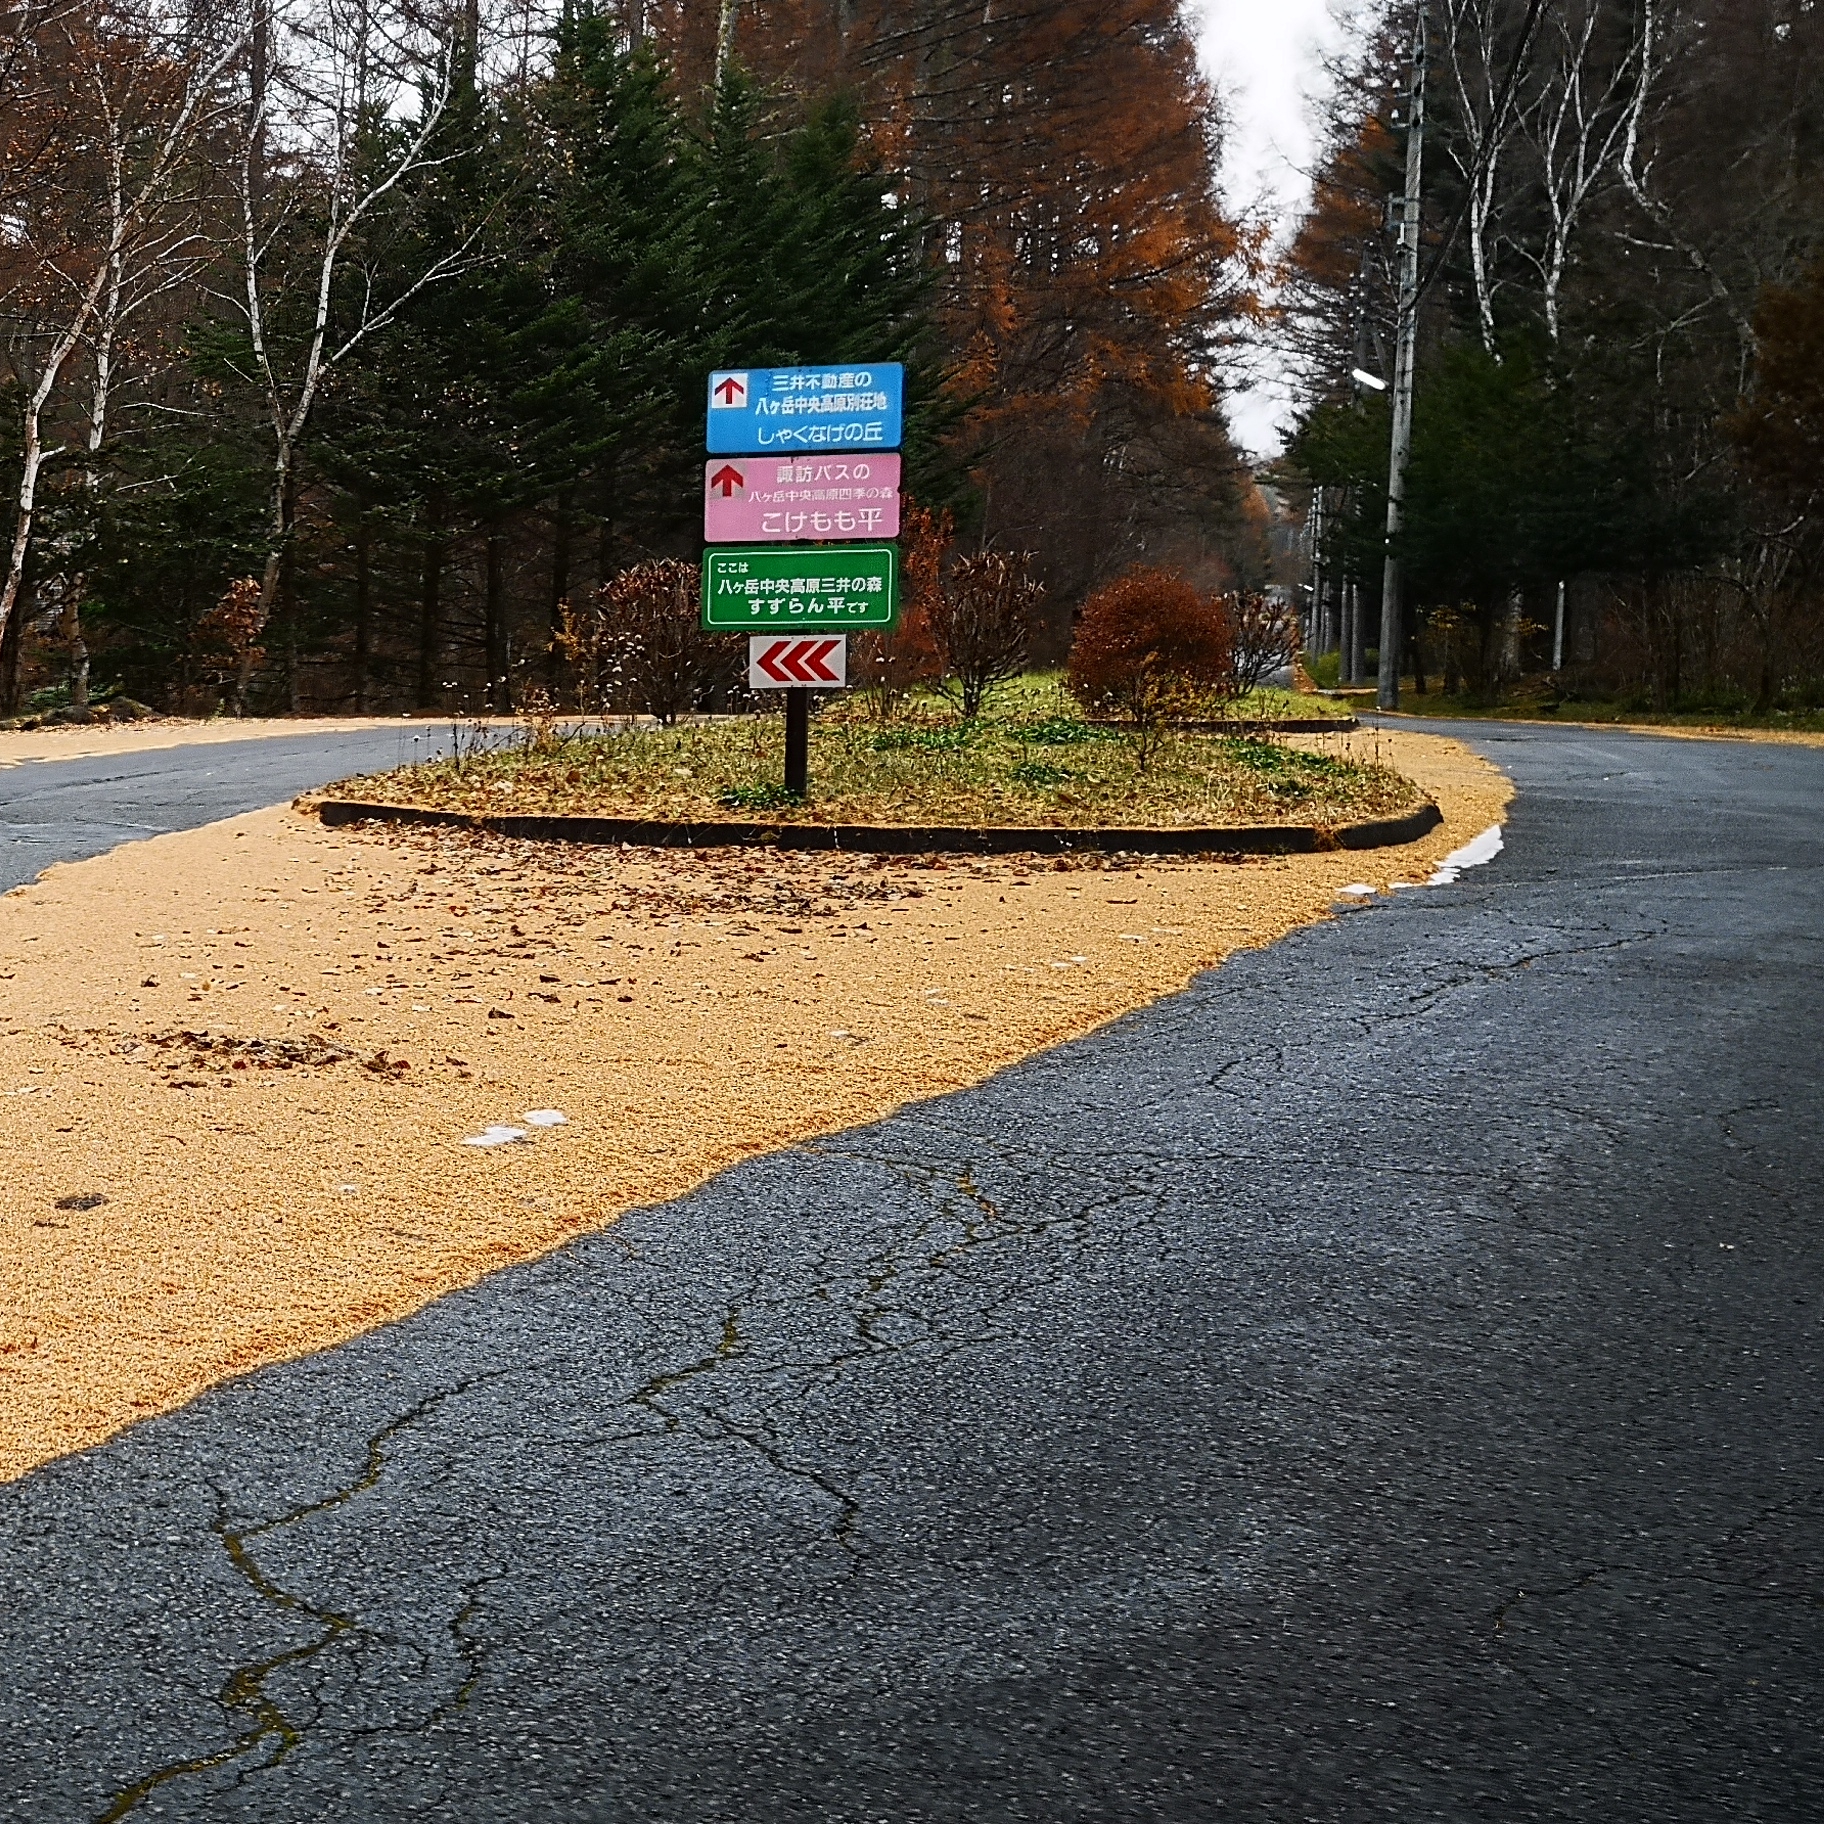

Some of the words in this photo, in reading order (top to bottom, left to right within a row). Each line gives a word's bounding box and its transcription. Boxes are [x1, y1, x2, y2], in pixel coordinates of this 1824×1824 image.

[772, 371, 872, 392] 三井不動産の
[758, 422, 883, 445] しゃくなげの丘
[776, 463, 870, 484] 諏訪バスの
[762, 508, 883, 533] こけもも平
[717, 562, 749, 574] ここは
